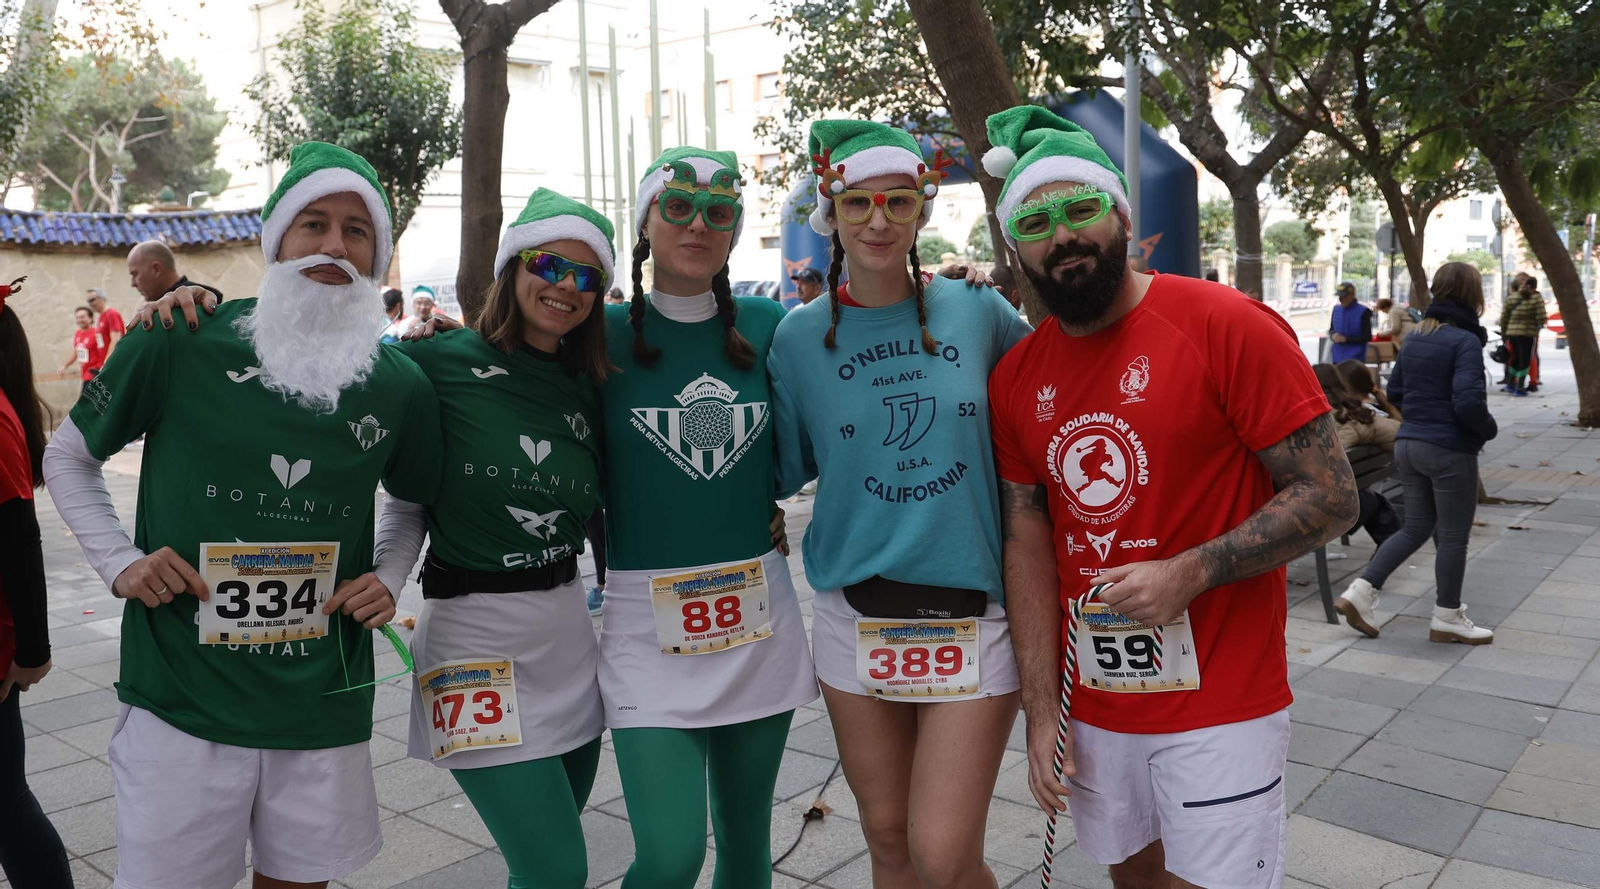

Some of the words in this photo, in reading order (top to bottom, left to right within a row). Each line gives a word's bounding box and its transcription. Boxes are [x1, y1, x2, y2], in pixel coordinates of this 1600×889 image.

[1010, 199, 1040, 216] HAPPY
[1041, 189, 1067, 203] NEW
[1070, 184, 1097, 196] YEAR
[838, 339, 919, 380] O'NEILL
[871, 376, 895, 387] 41st
[898, 370, 927, 384] AVE.
[958, 402, 976, 417] 52
[1037, 401, 1054, 412] UCA
[839, 424, 855, 440] 19
[629, 417, 646, 435] PEÑA
[646, 431, 667, 454] BÉTICA
[666, 451, 699, 480] ALGECIRAS
[718, 461, 735, 478] PEÑA
[734, 440, 753, 463] BÉTICA
[752, 409, 770, 442] ALGECIRAS
[1046, 435, 1063, 483] CARRERA
[1059, 412, 1114, 436] SOLIDARIA
[1115, 418, 1130, 433] DE
[1127, 430, 1149, 486] NAVIDAD
[897, 456, 933, 472] U.S.A.
[465, 463, 591, 494] BOTANIC
[864, 461, 968, 503] CALIFORNIA
[206, 485, 351, 517] BOTANIC
[1091, 517, 1100, 525] DE
[1101, 495, 1136, 524] ALGECIRAS
[256, 511, 310, 522] ALGECIRAS
[1119, 538, 1158, 549] EVOS
[231, 554, 277, 569] CARRERA
[278, 553, 315, 568] NAVIDAD
[1079, 568, 1109, 576] CUP
[672, 579, 710, 595] CARRERA
[711, 571, 746, 588] NAVIDAD
[216, 578, 317, 619] 334
[287, 617, 304, 625] ANDRÉS
[682, 595, 742, 634] 88
[928, 609, 951, 617] Boxiki
[691, 633, 706, 641] SOUZA
[879, 627, 918, 639] CARRERA
[919, 626, 956, 638] NAVIDAD
[212, 641, 309, 656] URIAL
[1092, 634, 1154, 670] 59
[868, 645, 963, 680] 389
[454, 669, 491, 684] NAVIDAD
[432, 690, 503, 733] 473
